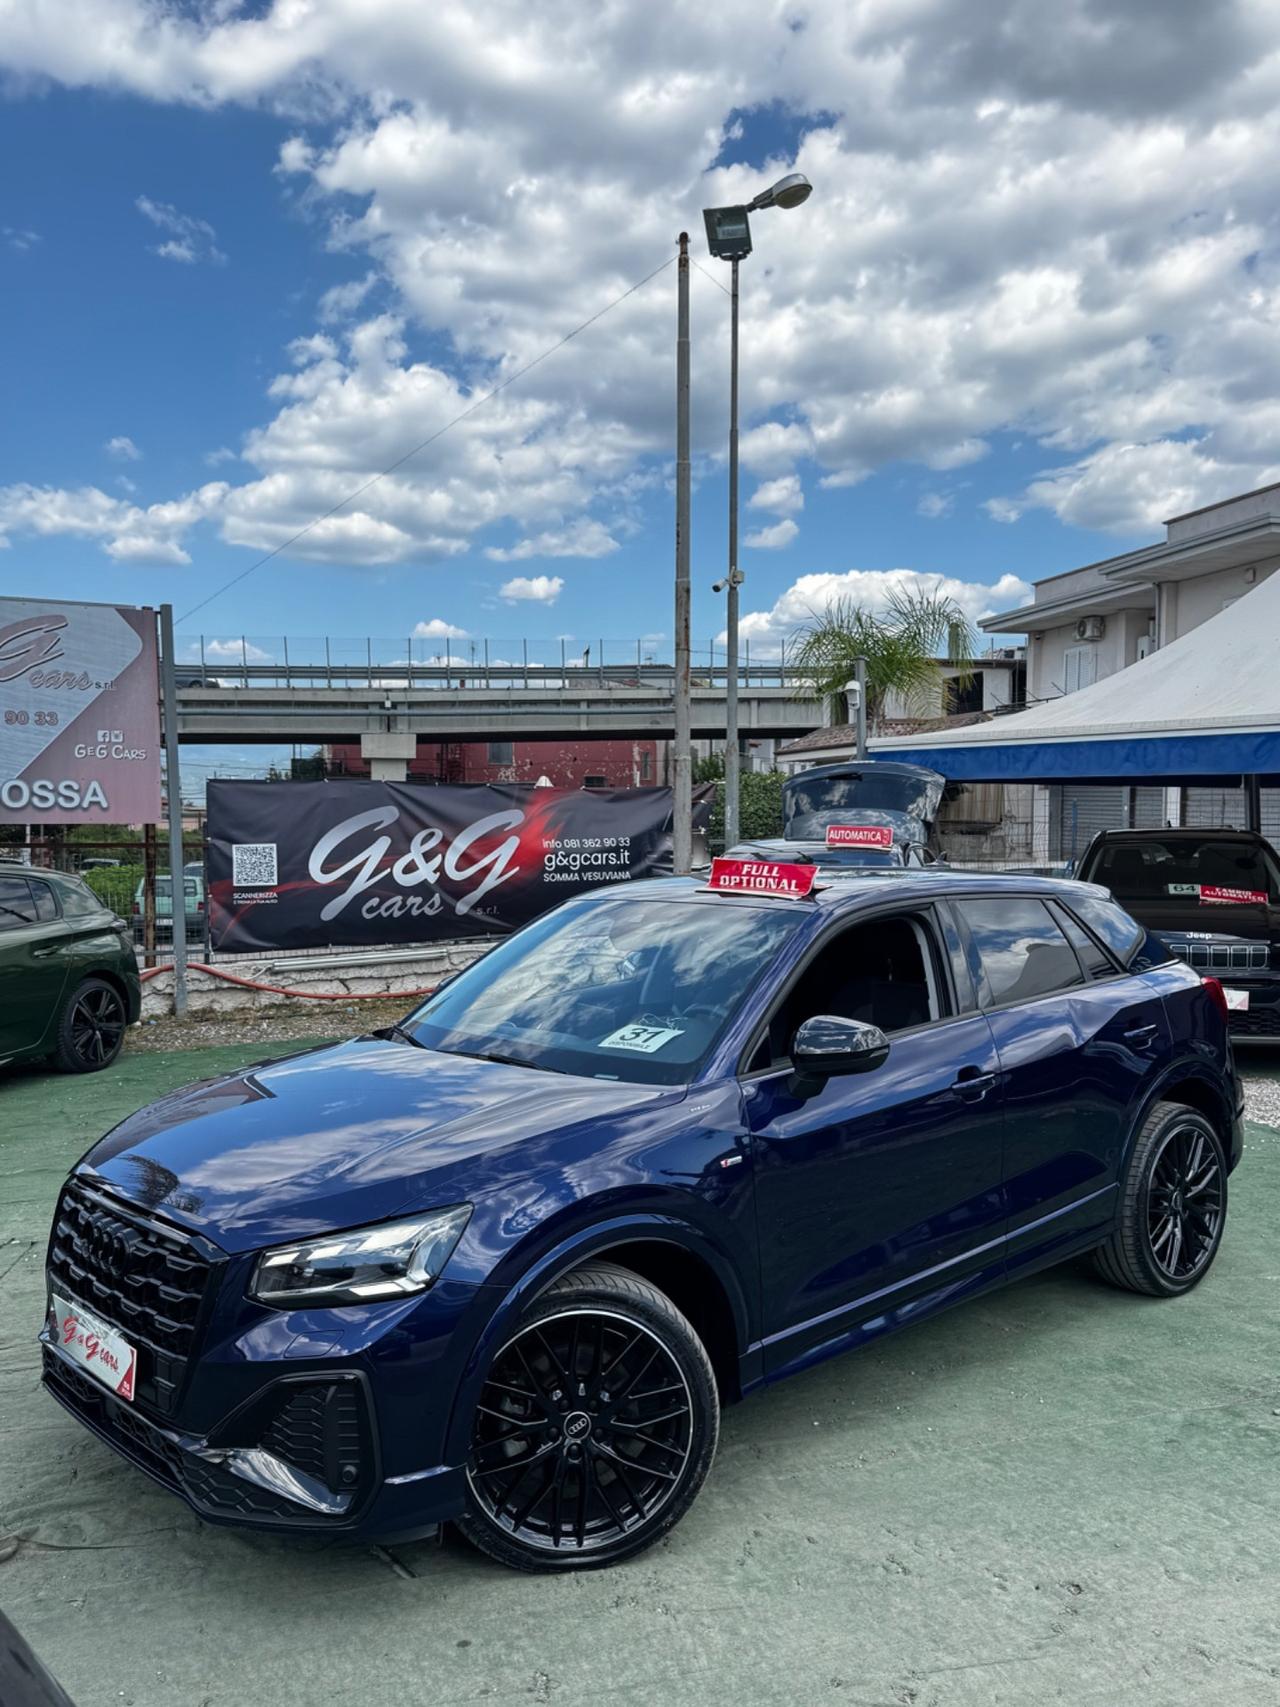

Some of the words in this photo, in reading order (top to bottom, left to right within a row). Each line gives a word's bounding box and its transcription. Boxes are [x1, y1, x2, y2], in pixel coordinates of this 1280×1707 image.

[4, 710, 29, 725] 90
[34, 711, 59, 726] 33
[1, 780, 108, 808] OSSA
[564, 839, 580, 848] 081
[582, 838, 601, 848] 362
[603, 837, 616, 847] 90
[618, 836, 630, 847] 33
[829, 829, 882, 842] AUTOMATICA
[544, 849, 630, 871] g&gcars.it
[543, 873, 579, 882] SOMMA
[582, 871, 631, 881] VESUVIANA
[742, 864, 780, 877] FULL
[719, 875, 799, 891] OPTIONAL
[1204, 890, 1264, 901] AUTOMATICO
[361, 893, 443, 919] cars
[1186, 932, 1212, 940] Jeep
[620, 1028, 665, 1043] 31
